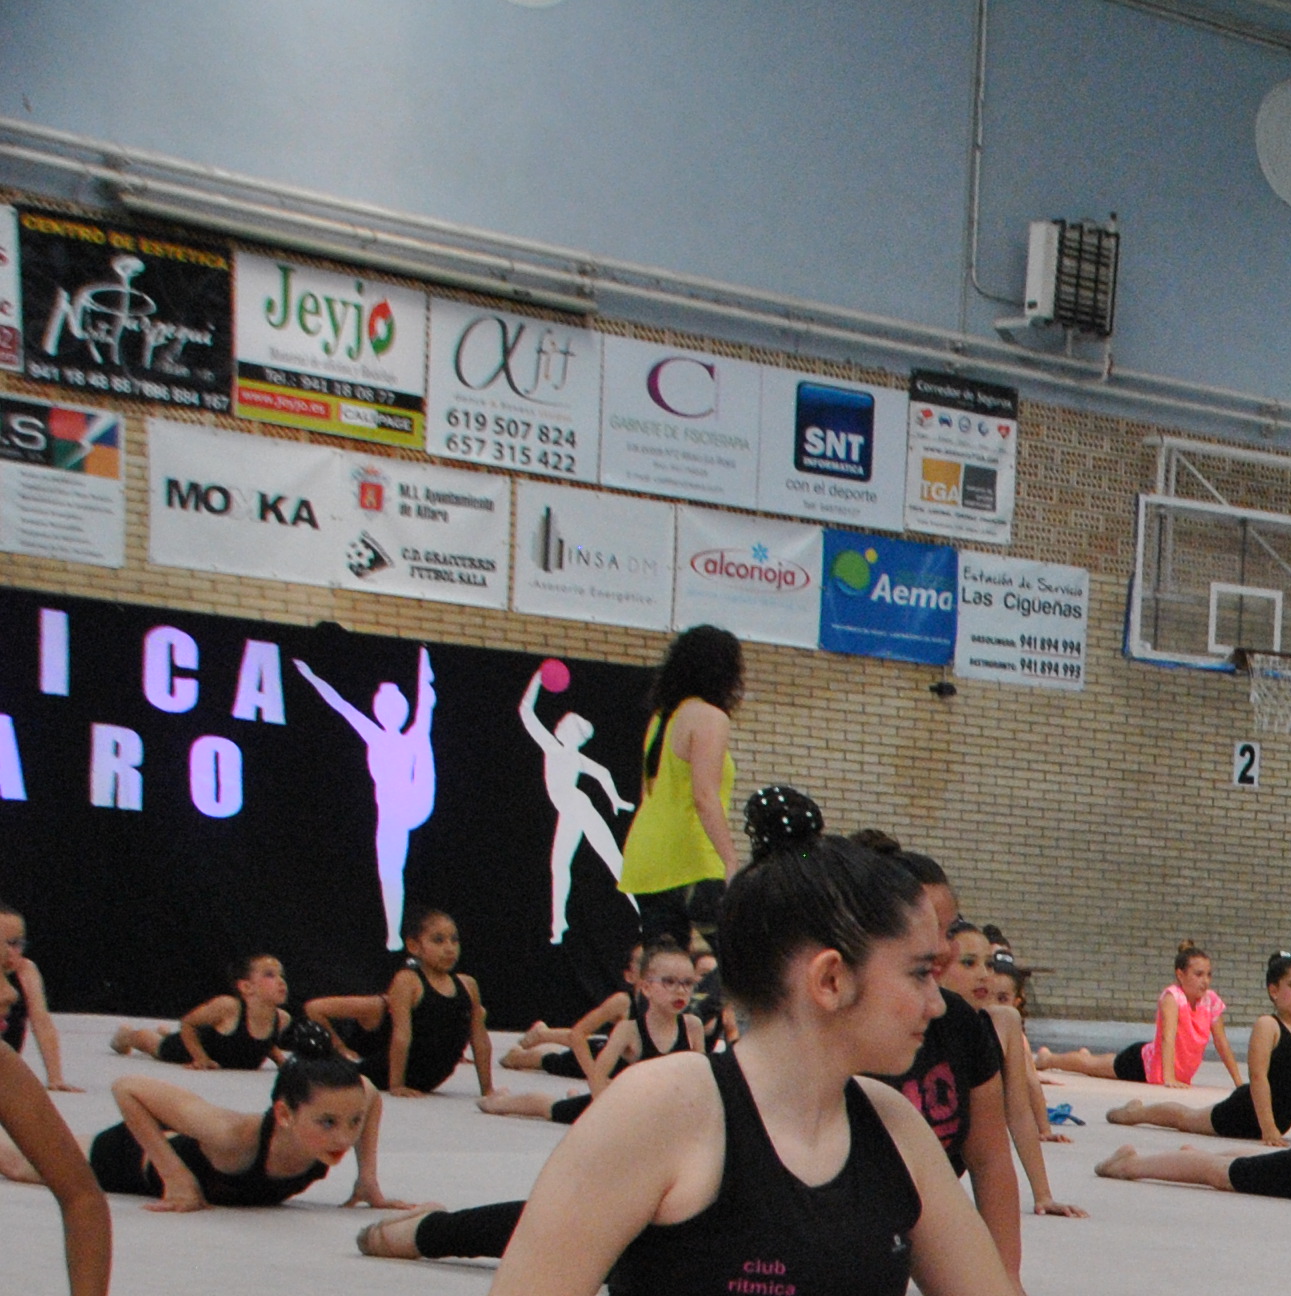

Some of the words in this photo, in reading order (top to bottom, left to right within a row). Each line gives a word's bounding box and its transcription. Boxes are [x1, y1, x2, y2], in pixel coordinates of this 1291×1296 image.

[21, 212, 107, 245] CENTRO
[264, 263, 396, 361] Jeyjo
[647, 356, 716, 419] C
[447, 408, 488, 432] 619
[493, 415, 532, 440] 507
[538, 424, 577, 448] 824
[804, 426, 865, 462] SNT
[446, 433, 486, 456] 657
[493, 441, 532, 466] 315
[538, 451, 577, 474] 422
[785, 478, 810, 493] con
[814, 480, 826, 495] el
[829, 483, 878, 503] deporte
[920, 480, 960, 501] TGA
[567, 546, 620, 571] INSA
[704, 551, 796, 590] alconoja
[871, 572, 954, 611] Aema
[961, 586, 994, 607] Las
[1018, 576, 1032, 590] de
[1037, 577, 1083, 597] Servicio
[1020, 634, 1037, 650] 941
[1040, 636, 1059, 653] 894
[1062, 638, 1081, 656] 994
[1020, 657, 1037, 673] 941
[1040, 659, 1060, 676] 894
[1062, 662, 1081, 679] 993
[1237, 743, 1256, 785] 2
[743, 1258, 787, 1276] club
